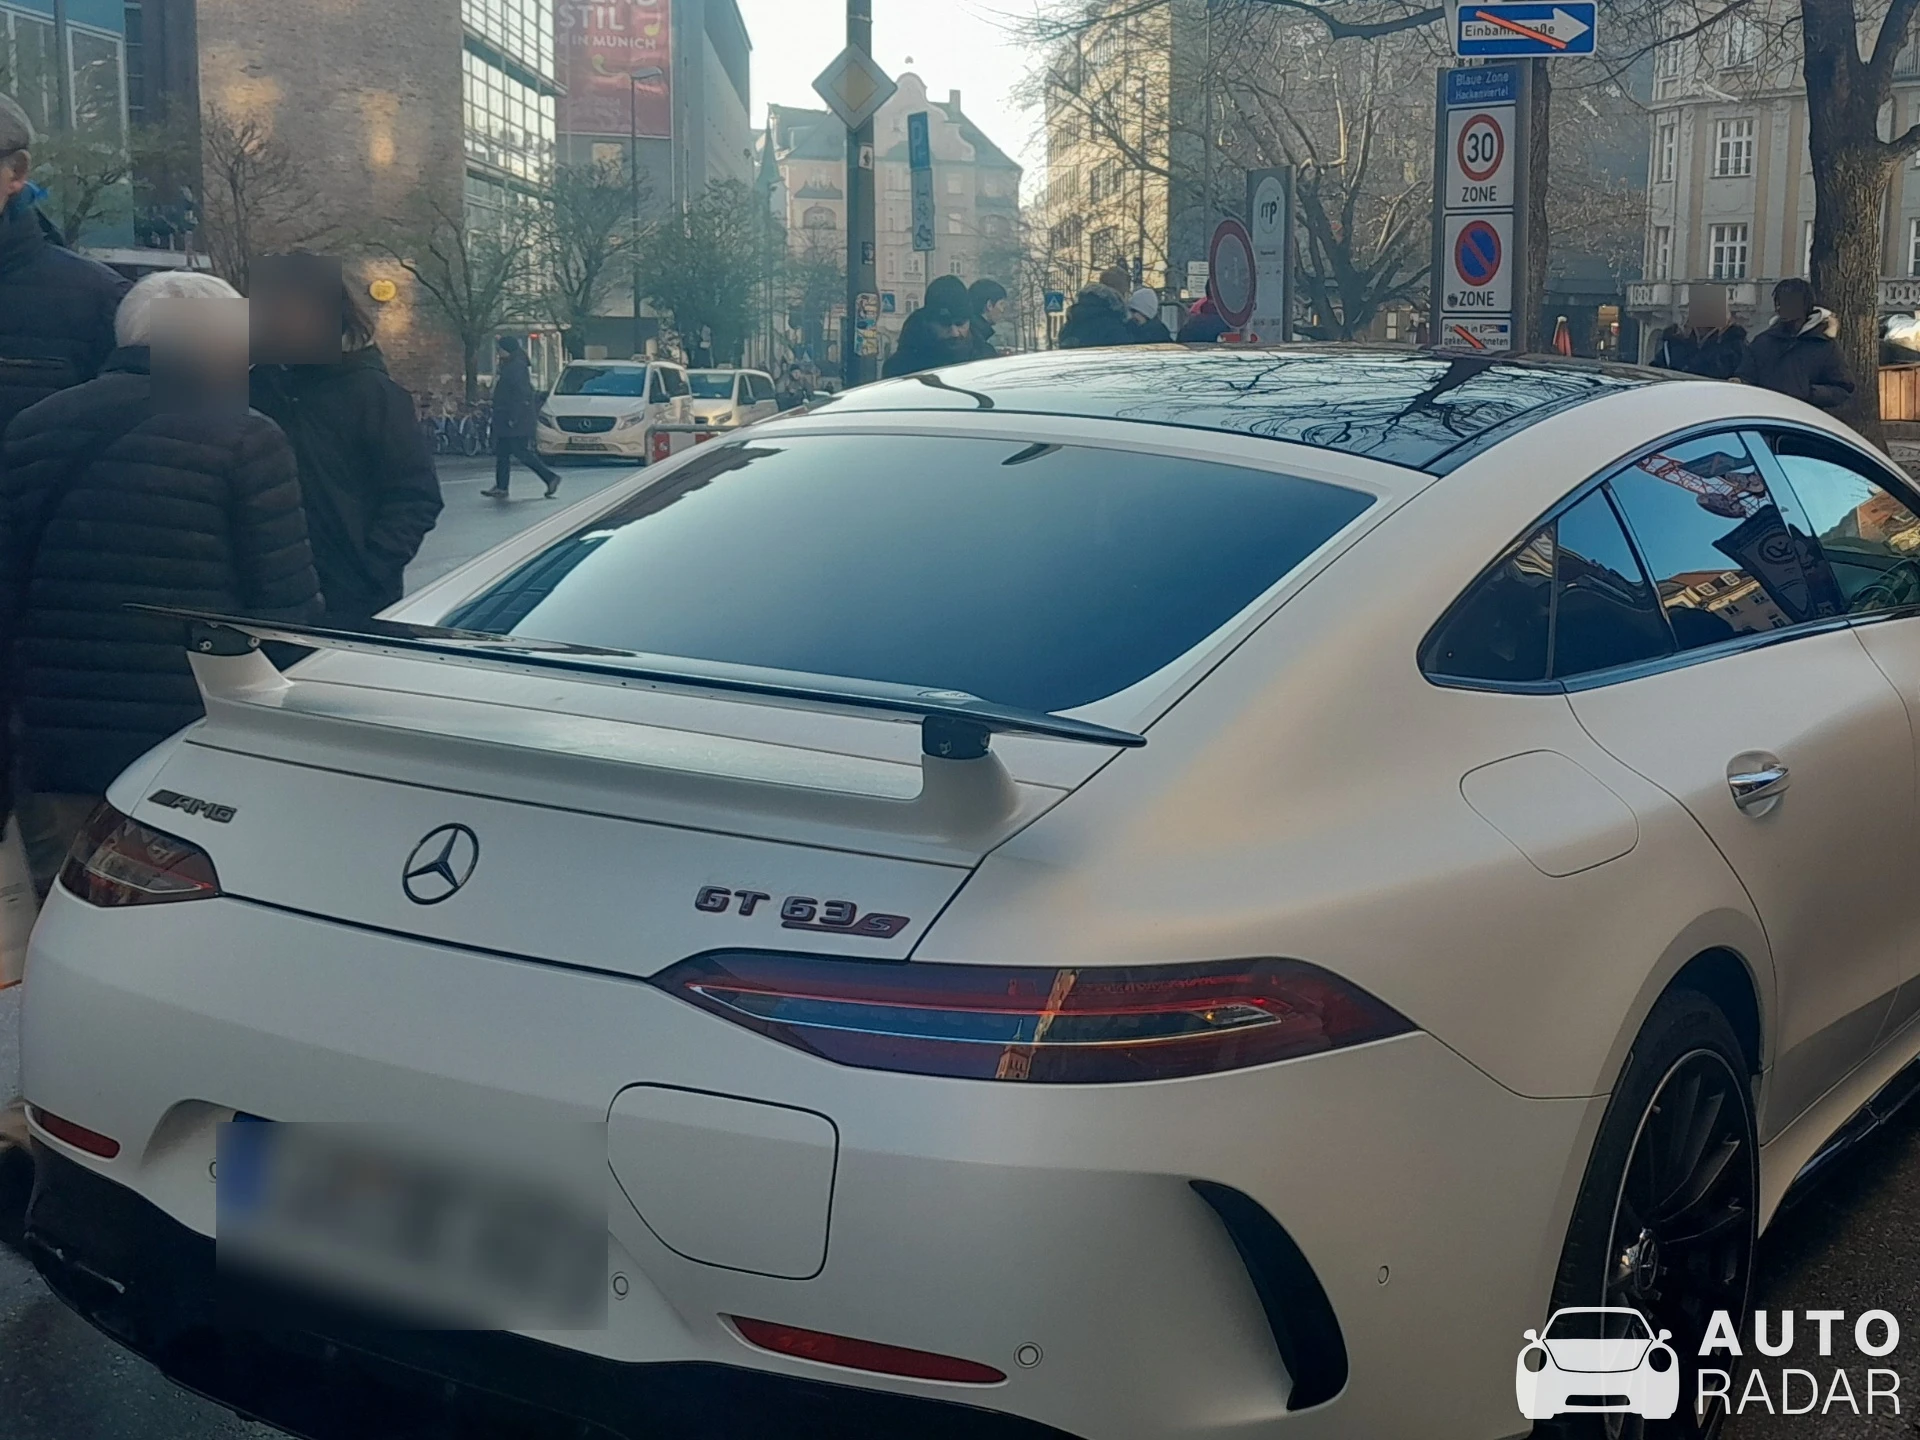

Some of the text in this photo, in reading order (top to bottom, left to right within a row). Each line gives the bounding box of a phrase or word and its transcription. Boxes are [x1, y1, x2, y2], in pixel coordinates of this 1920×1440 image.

[558, 4, 625, 30] STIL
[1465, 23, 1555, 37] Einbahnaße
[592, 35, 656, 49] MUNICH
[1466, 132, 1494, 163] 30
[1461, 185, 1497, 203] ZONE
[1459, 291, 1495, 306] ZONE
[171, 793, 237, 823] AMG
[694, 885, 771, 916] GT
